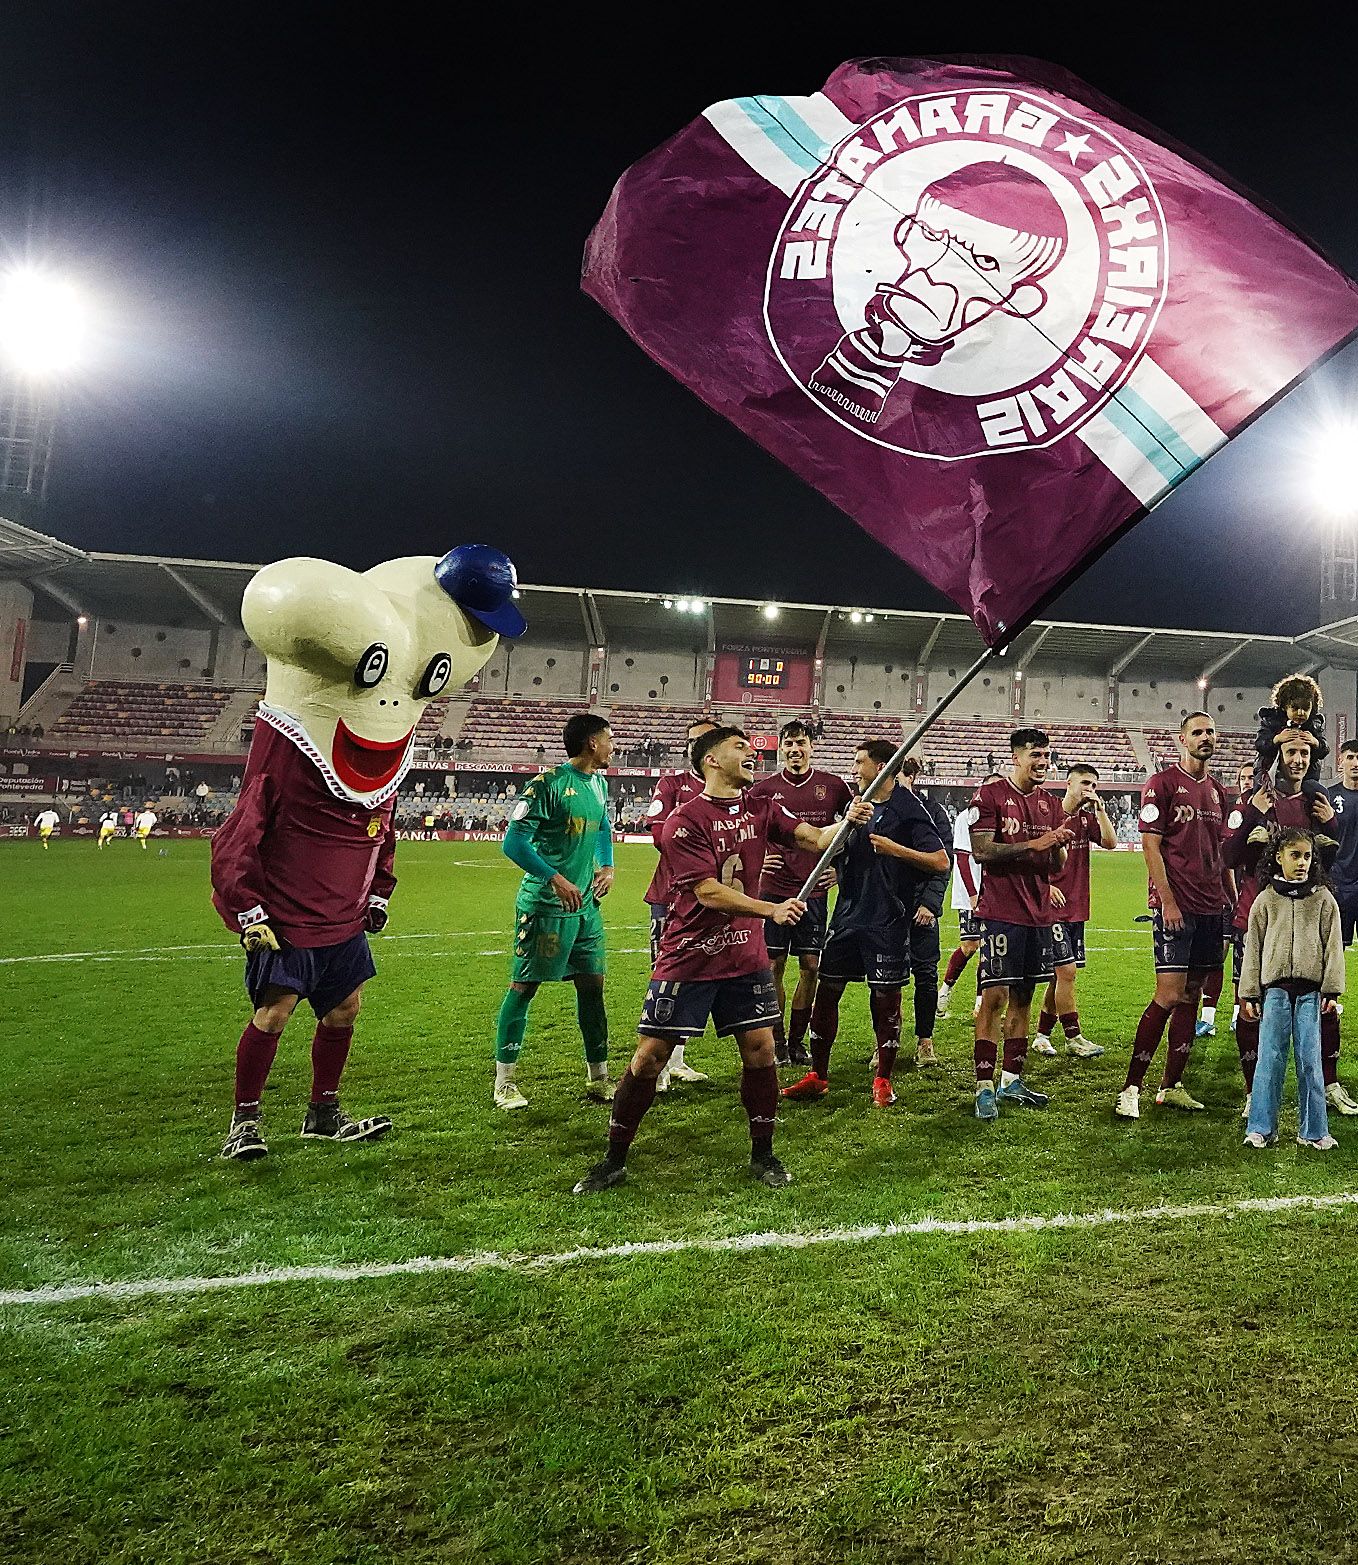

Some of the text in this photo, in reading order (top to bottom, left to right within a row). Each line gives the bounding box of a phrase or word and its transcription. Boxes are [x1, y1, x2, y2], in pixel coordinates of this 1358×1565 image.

[776, 661, 784, 672] 0
[747, 673, 780, 685] 90:00
[411, 761, 513, 772] SERVAS PESCAMAR
[394, 831, 505, 842] BANCA VIAQU
[1052, 923, 1063, 942] 8
[988, 933, 1008, 957] 19
